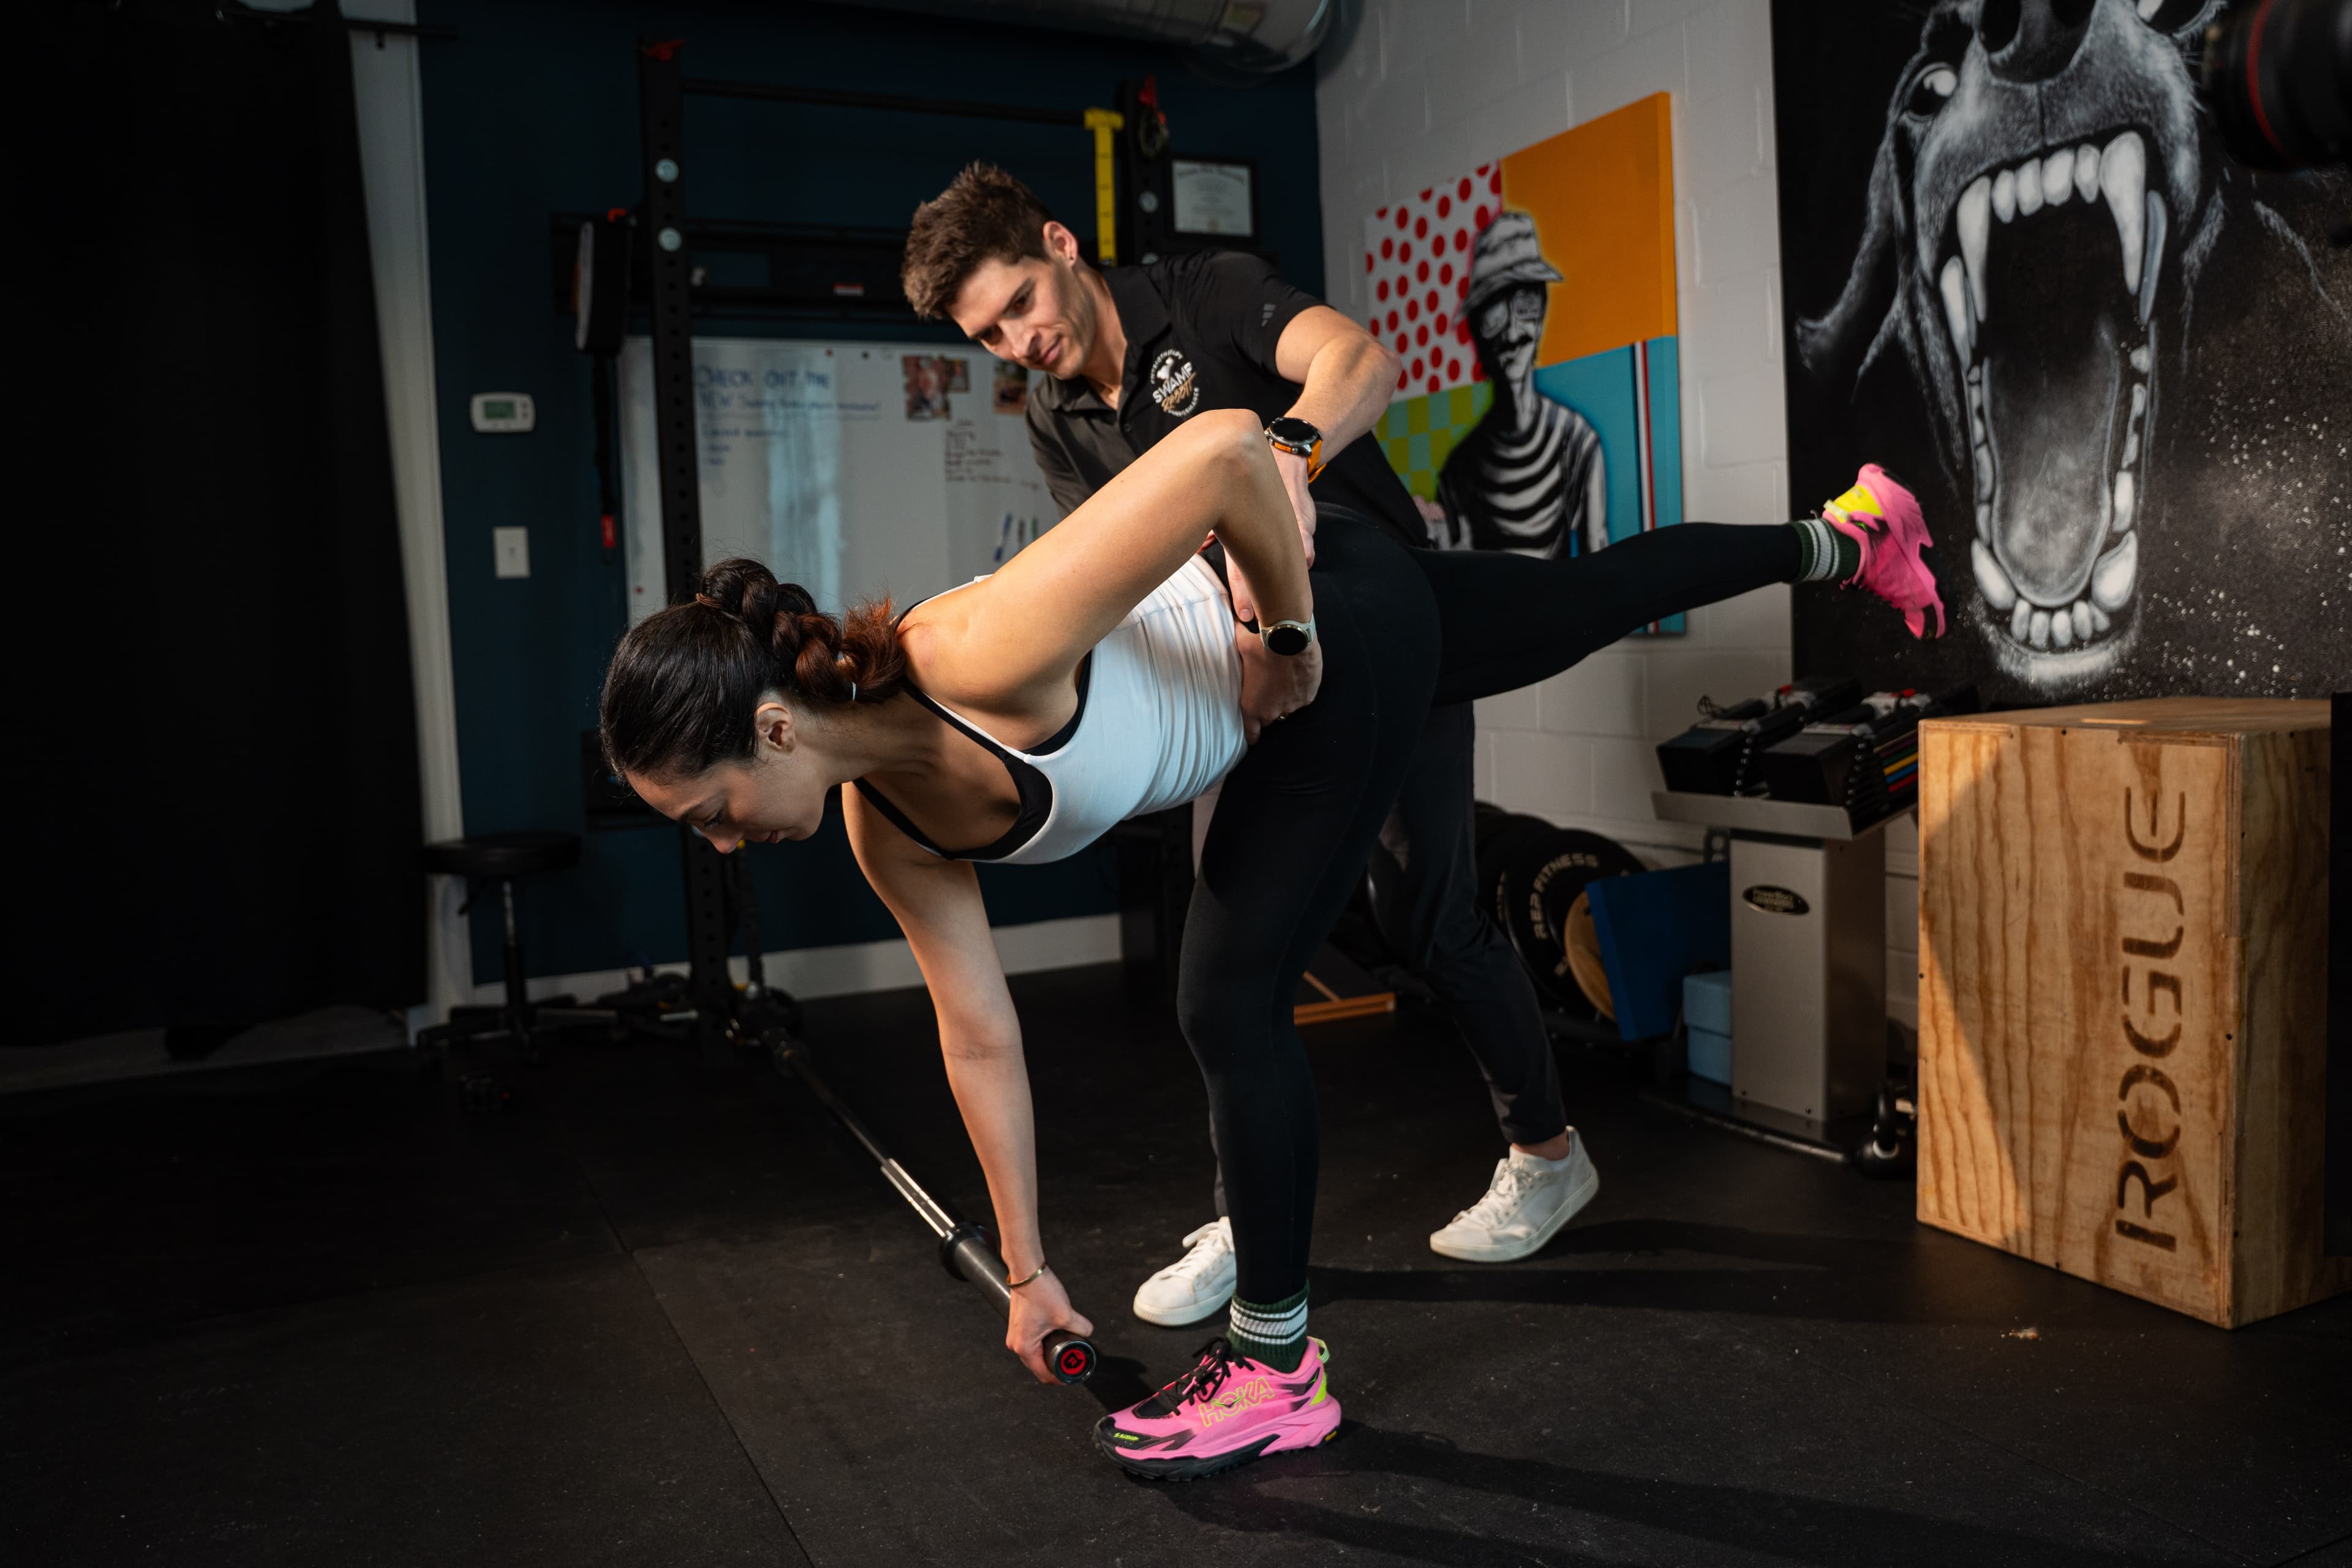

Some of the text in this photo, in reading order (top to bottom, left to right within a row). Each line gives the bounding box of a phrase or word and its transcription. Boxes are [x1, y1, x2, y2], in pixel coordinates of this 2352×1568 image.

[695, 366, 752, 390] CHECK
[764, 370, 797, 388] OUT
[1152, 361, 1193, 404] SWAMP
[1161, 372, 1197, 412] RABBIT
[1529, 852, 1600, 940] REP FITNESS
[2115, 786, 2187, 1253] ROGUE
[1198, 1376, 1275, 1428] HOKA
